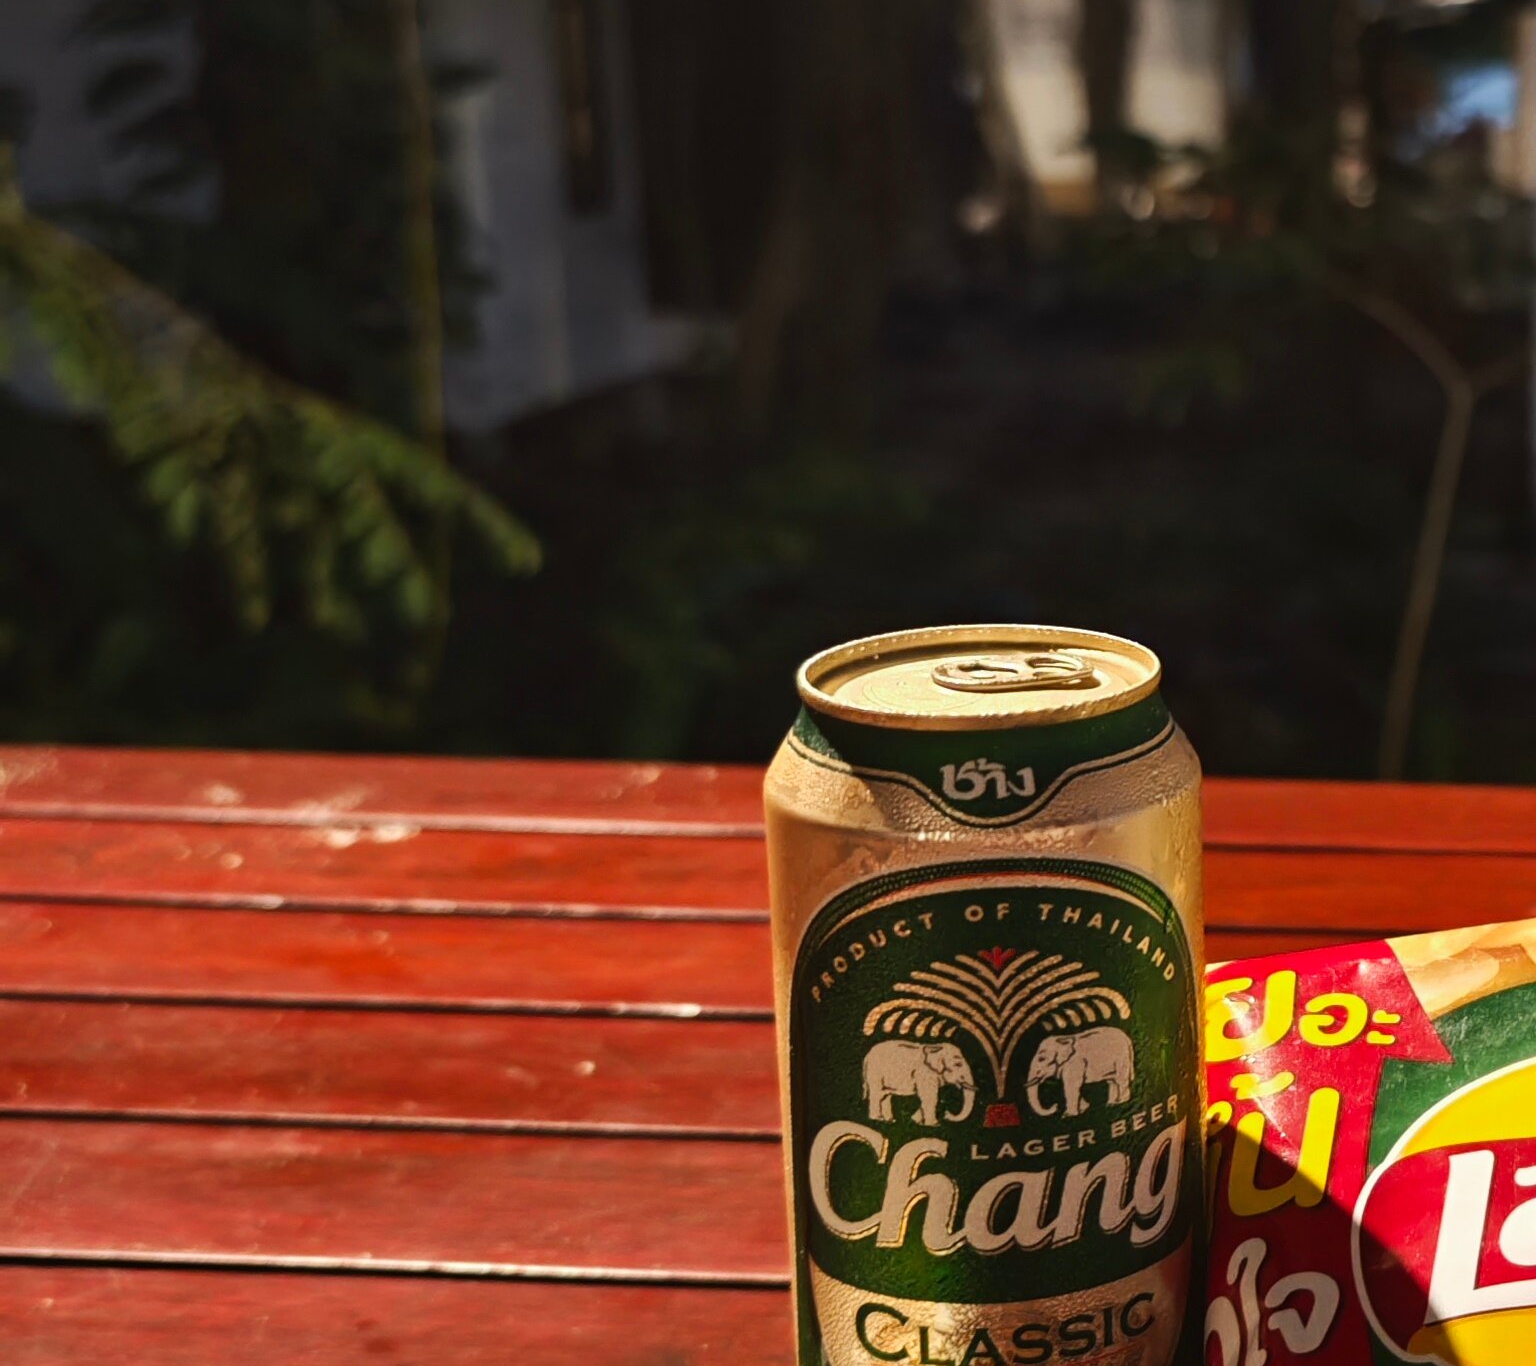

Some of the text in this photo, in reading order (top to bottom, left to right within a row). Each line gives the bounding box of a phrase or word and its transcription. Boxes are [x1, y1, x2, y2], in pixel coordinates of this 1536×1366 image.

[939, 757, 1036, 801] ช้าง
[812, 902, 1176, 1002] PRODUCT OF THAILAND
[970, 1094, 1178, 1161] LAGER BEER
[809, 1114, 1187, 1256] Chang
[854, 1291, 1156, 1366] CLASSIC
